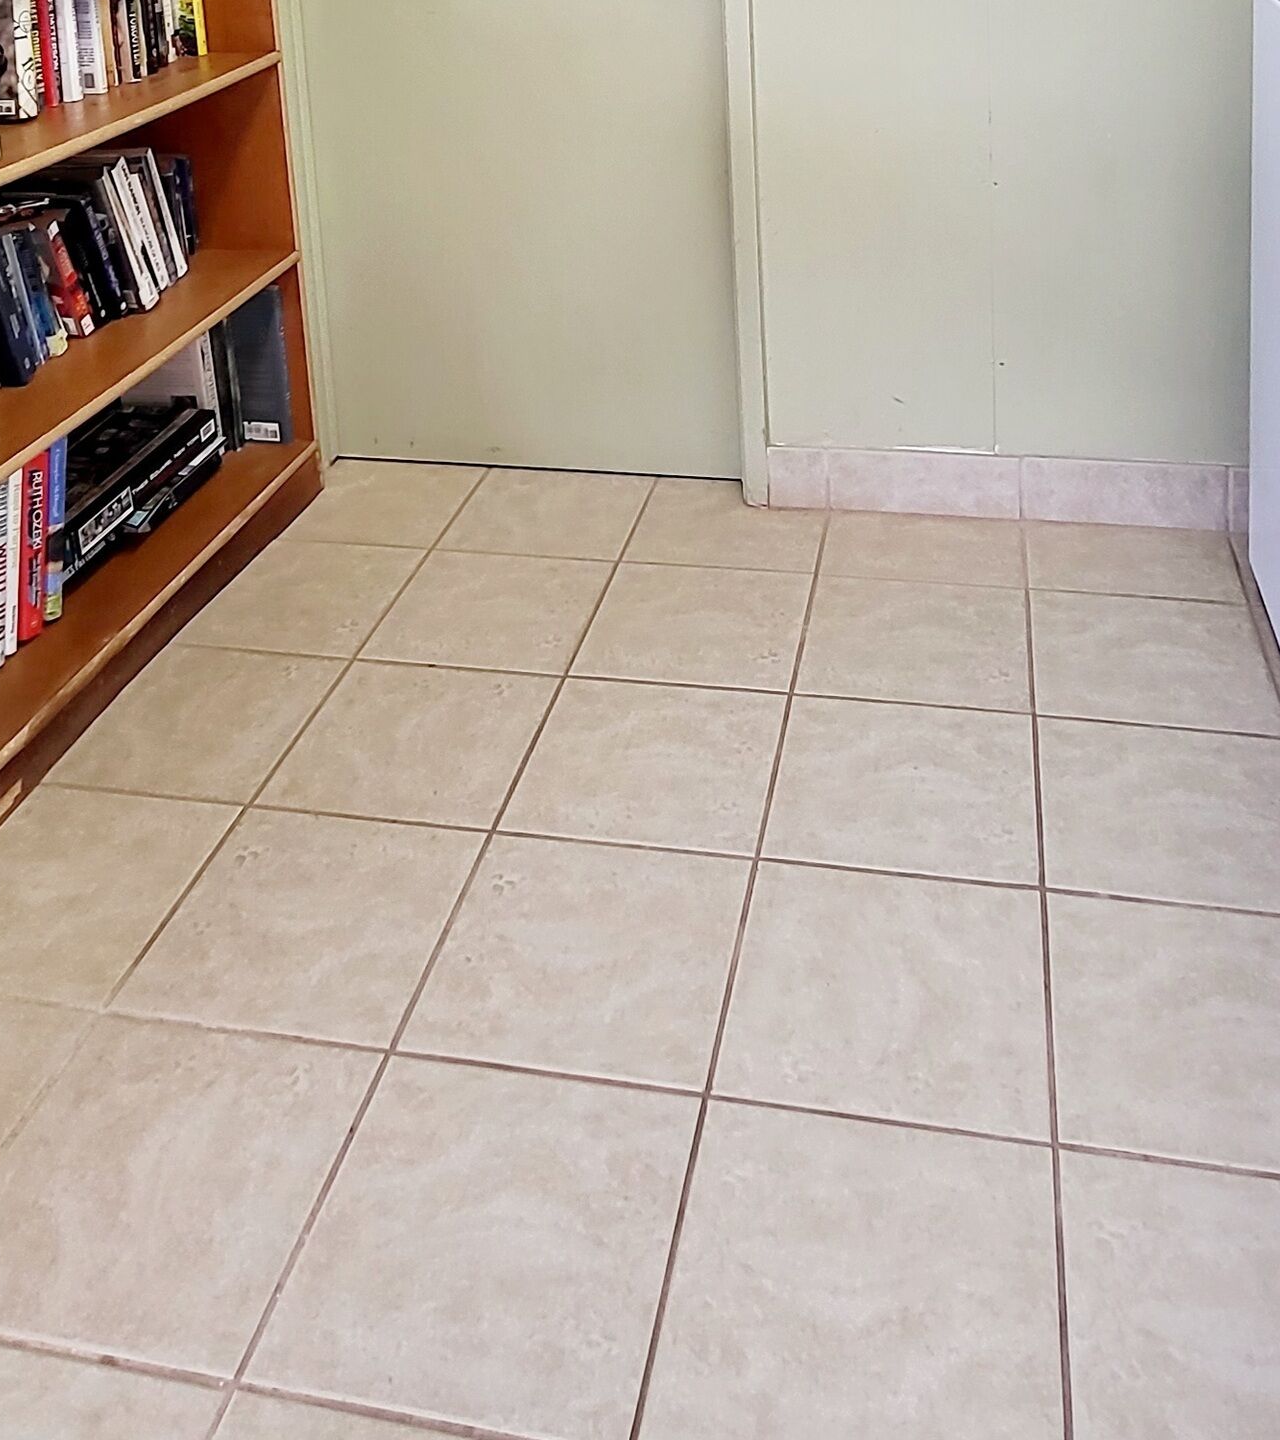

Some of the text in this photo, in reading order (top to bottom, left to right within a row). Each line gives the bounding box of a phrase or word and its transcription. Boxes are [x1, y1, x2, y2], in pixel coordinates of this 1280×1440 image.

[48, 14, 60, 72] PATTERSON
[32, 471, 43, 508] RUTH
[32, 509, 44, 550] OZEKI
